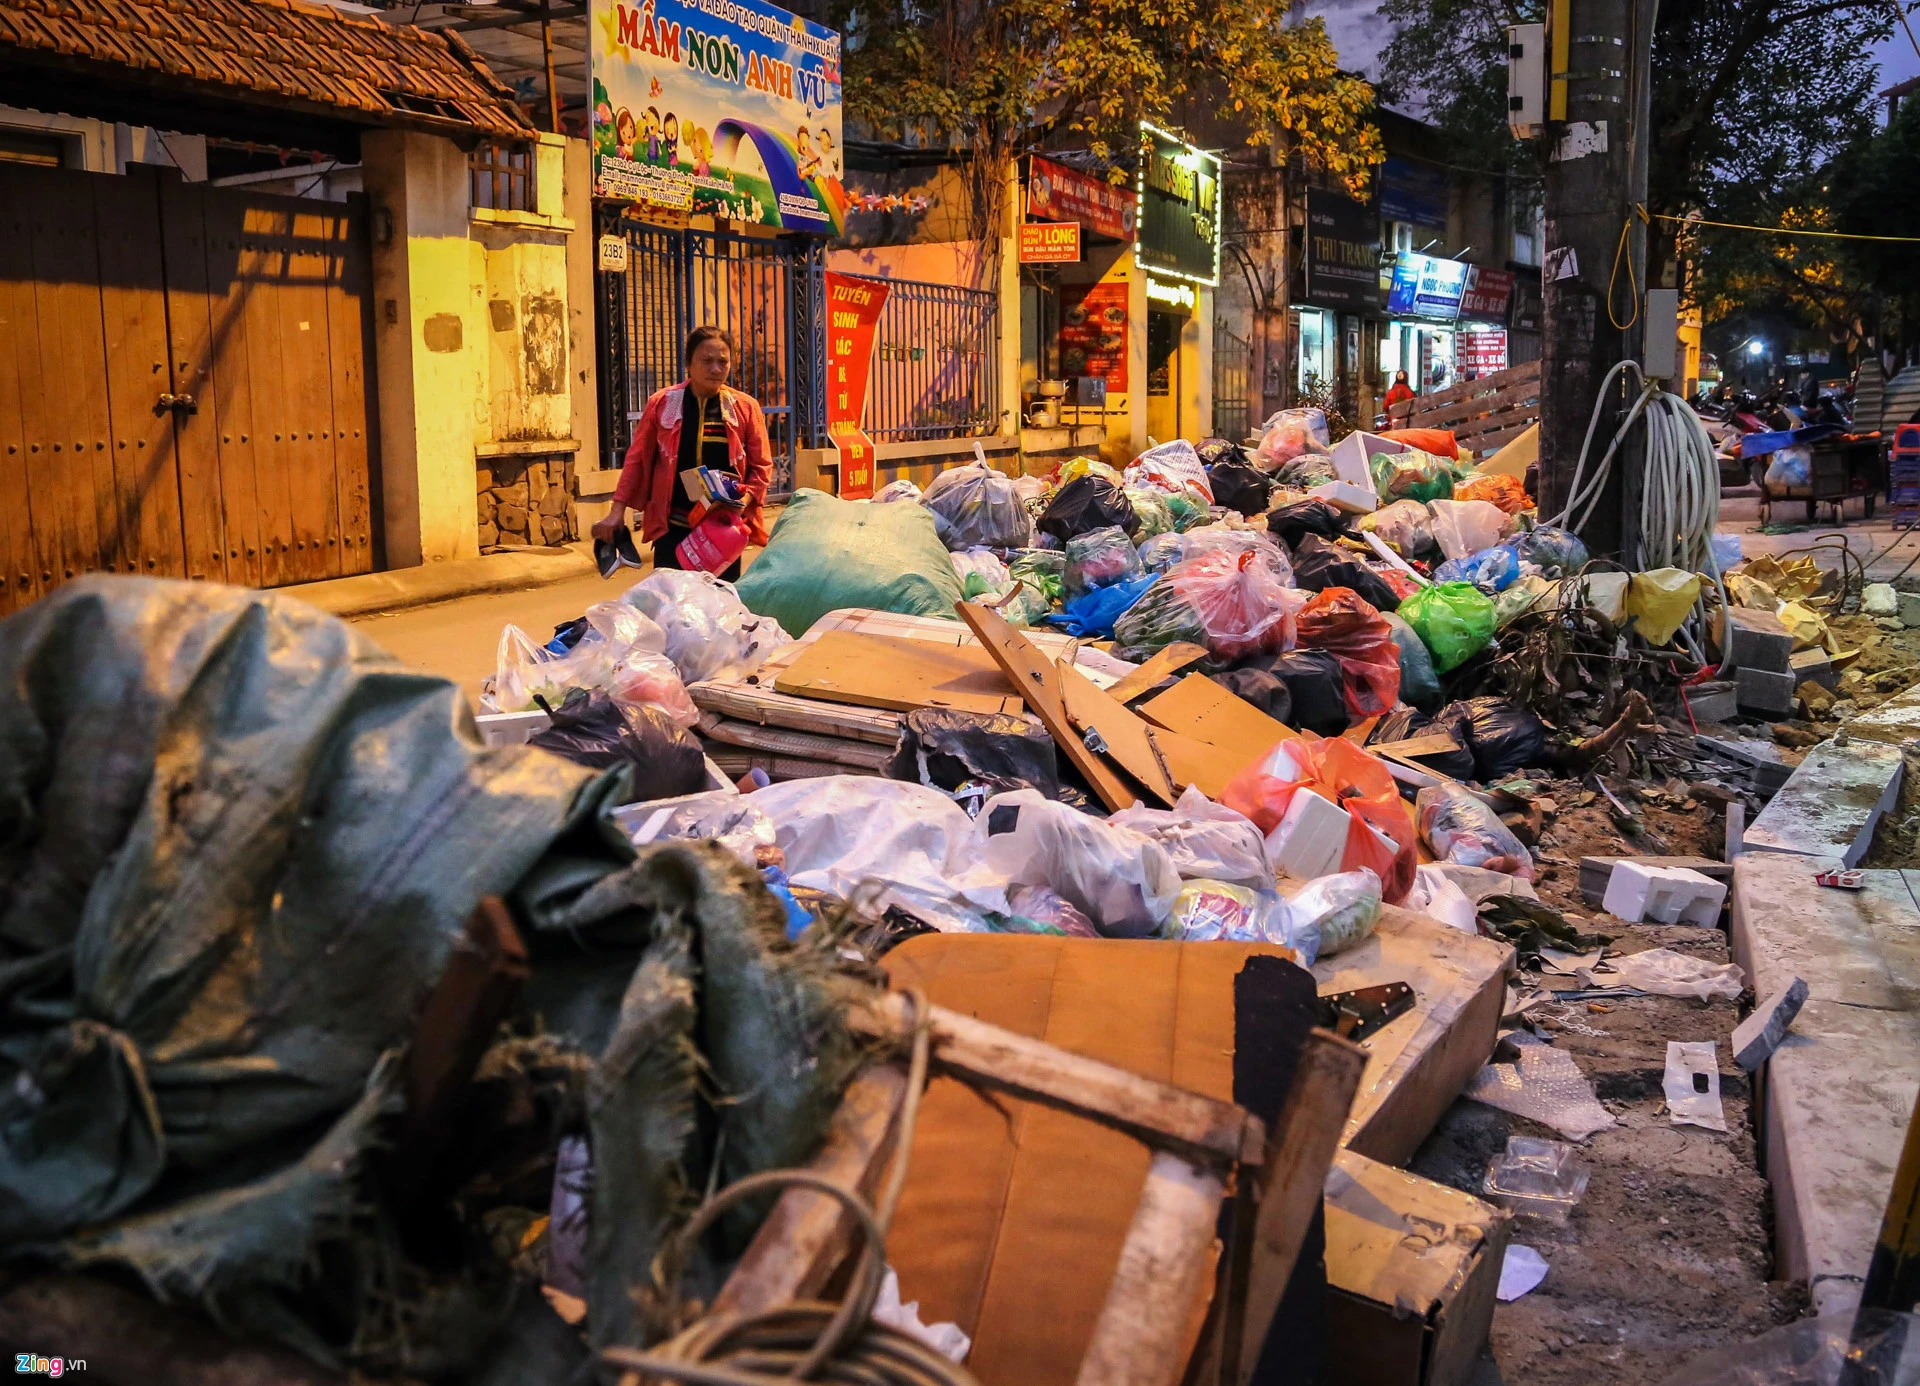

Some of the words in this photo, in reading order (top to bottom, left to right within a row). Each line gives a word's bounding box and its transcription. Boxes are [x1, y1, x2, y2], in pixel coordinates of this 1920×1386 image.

[737, 7, 757, 31] TẠO
[758, 15, 784, 43] QUẬN
[785, 26, 813, 52] THANH
[814, 37, 838, 61] XUÂN
[687, 29, 740, 83] NON
[745, 51, 794, 100] ANH
[798, 66, 826, 109] VŨ
[640, 189, 648, 197] 193
[1023, 227, 1038, 235] CHÁO
[1045, 225, 1075, 244] LÒNG
[1023, 237, 1038, 245] BÚN
[603, 243, 623, 259] 23B2
[1314, 236, 1337, 260] THU
[1339, 240, 1375, 267] TRANG
[833, 285, 871, 306] TUYỂN
[833, 311, 859, 328] SINH
[836, 336, 852, 355] CÁC
[1467, 355, 1475, 364] XE
[1476, 355, 1484, 364] GA
[1488, 355, 1497, 364] XE
[849, 471, 854, 487] 5
